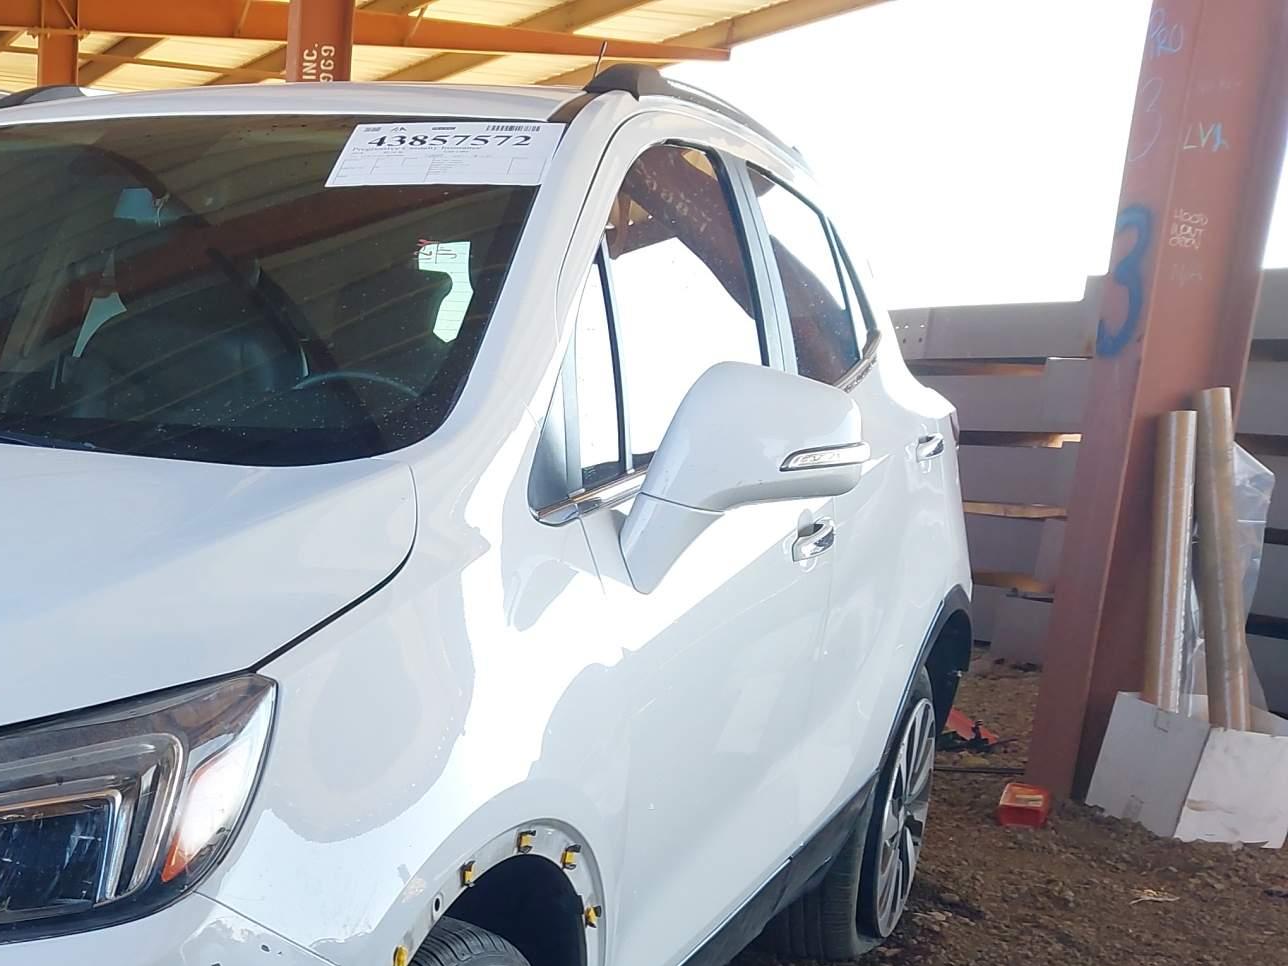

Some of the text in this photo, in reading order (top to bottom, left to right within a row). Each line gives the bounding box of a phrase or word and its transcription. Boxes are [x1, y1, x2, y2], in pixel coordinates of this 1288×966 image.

[302, 43, 318, 80] INC.
[368, 134, 532, 147] 43857572
[1096, 204, 1151, 358] 3
